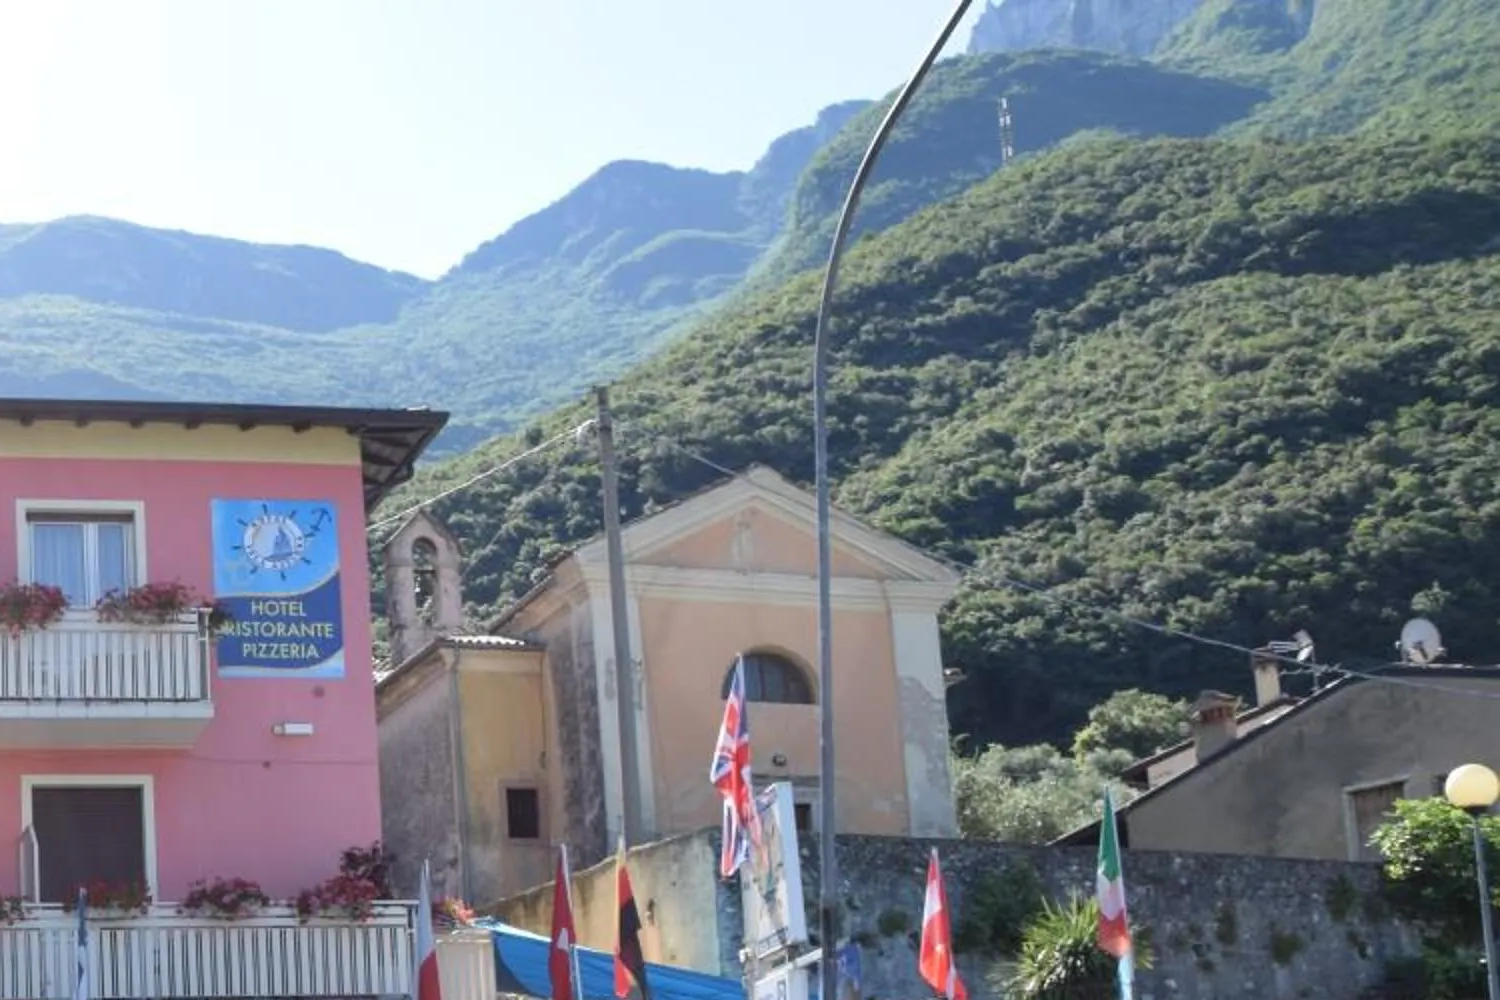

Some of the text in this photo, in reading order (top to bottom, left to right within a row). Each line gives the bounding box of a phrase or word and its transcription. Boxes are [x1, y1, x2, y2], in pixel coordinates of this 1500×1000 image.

[250, 600, 307, 617] HOTEL
[225, 621, 334, 639] RISTORANTE
[242, 643, 320, 660] PIZZERIA
